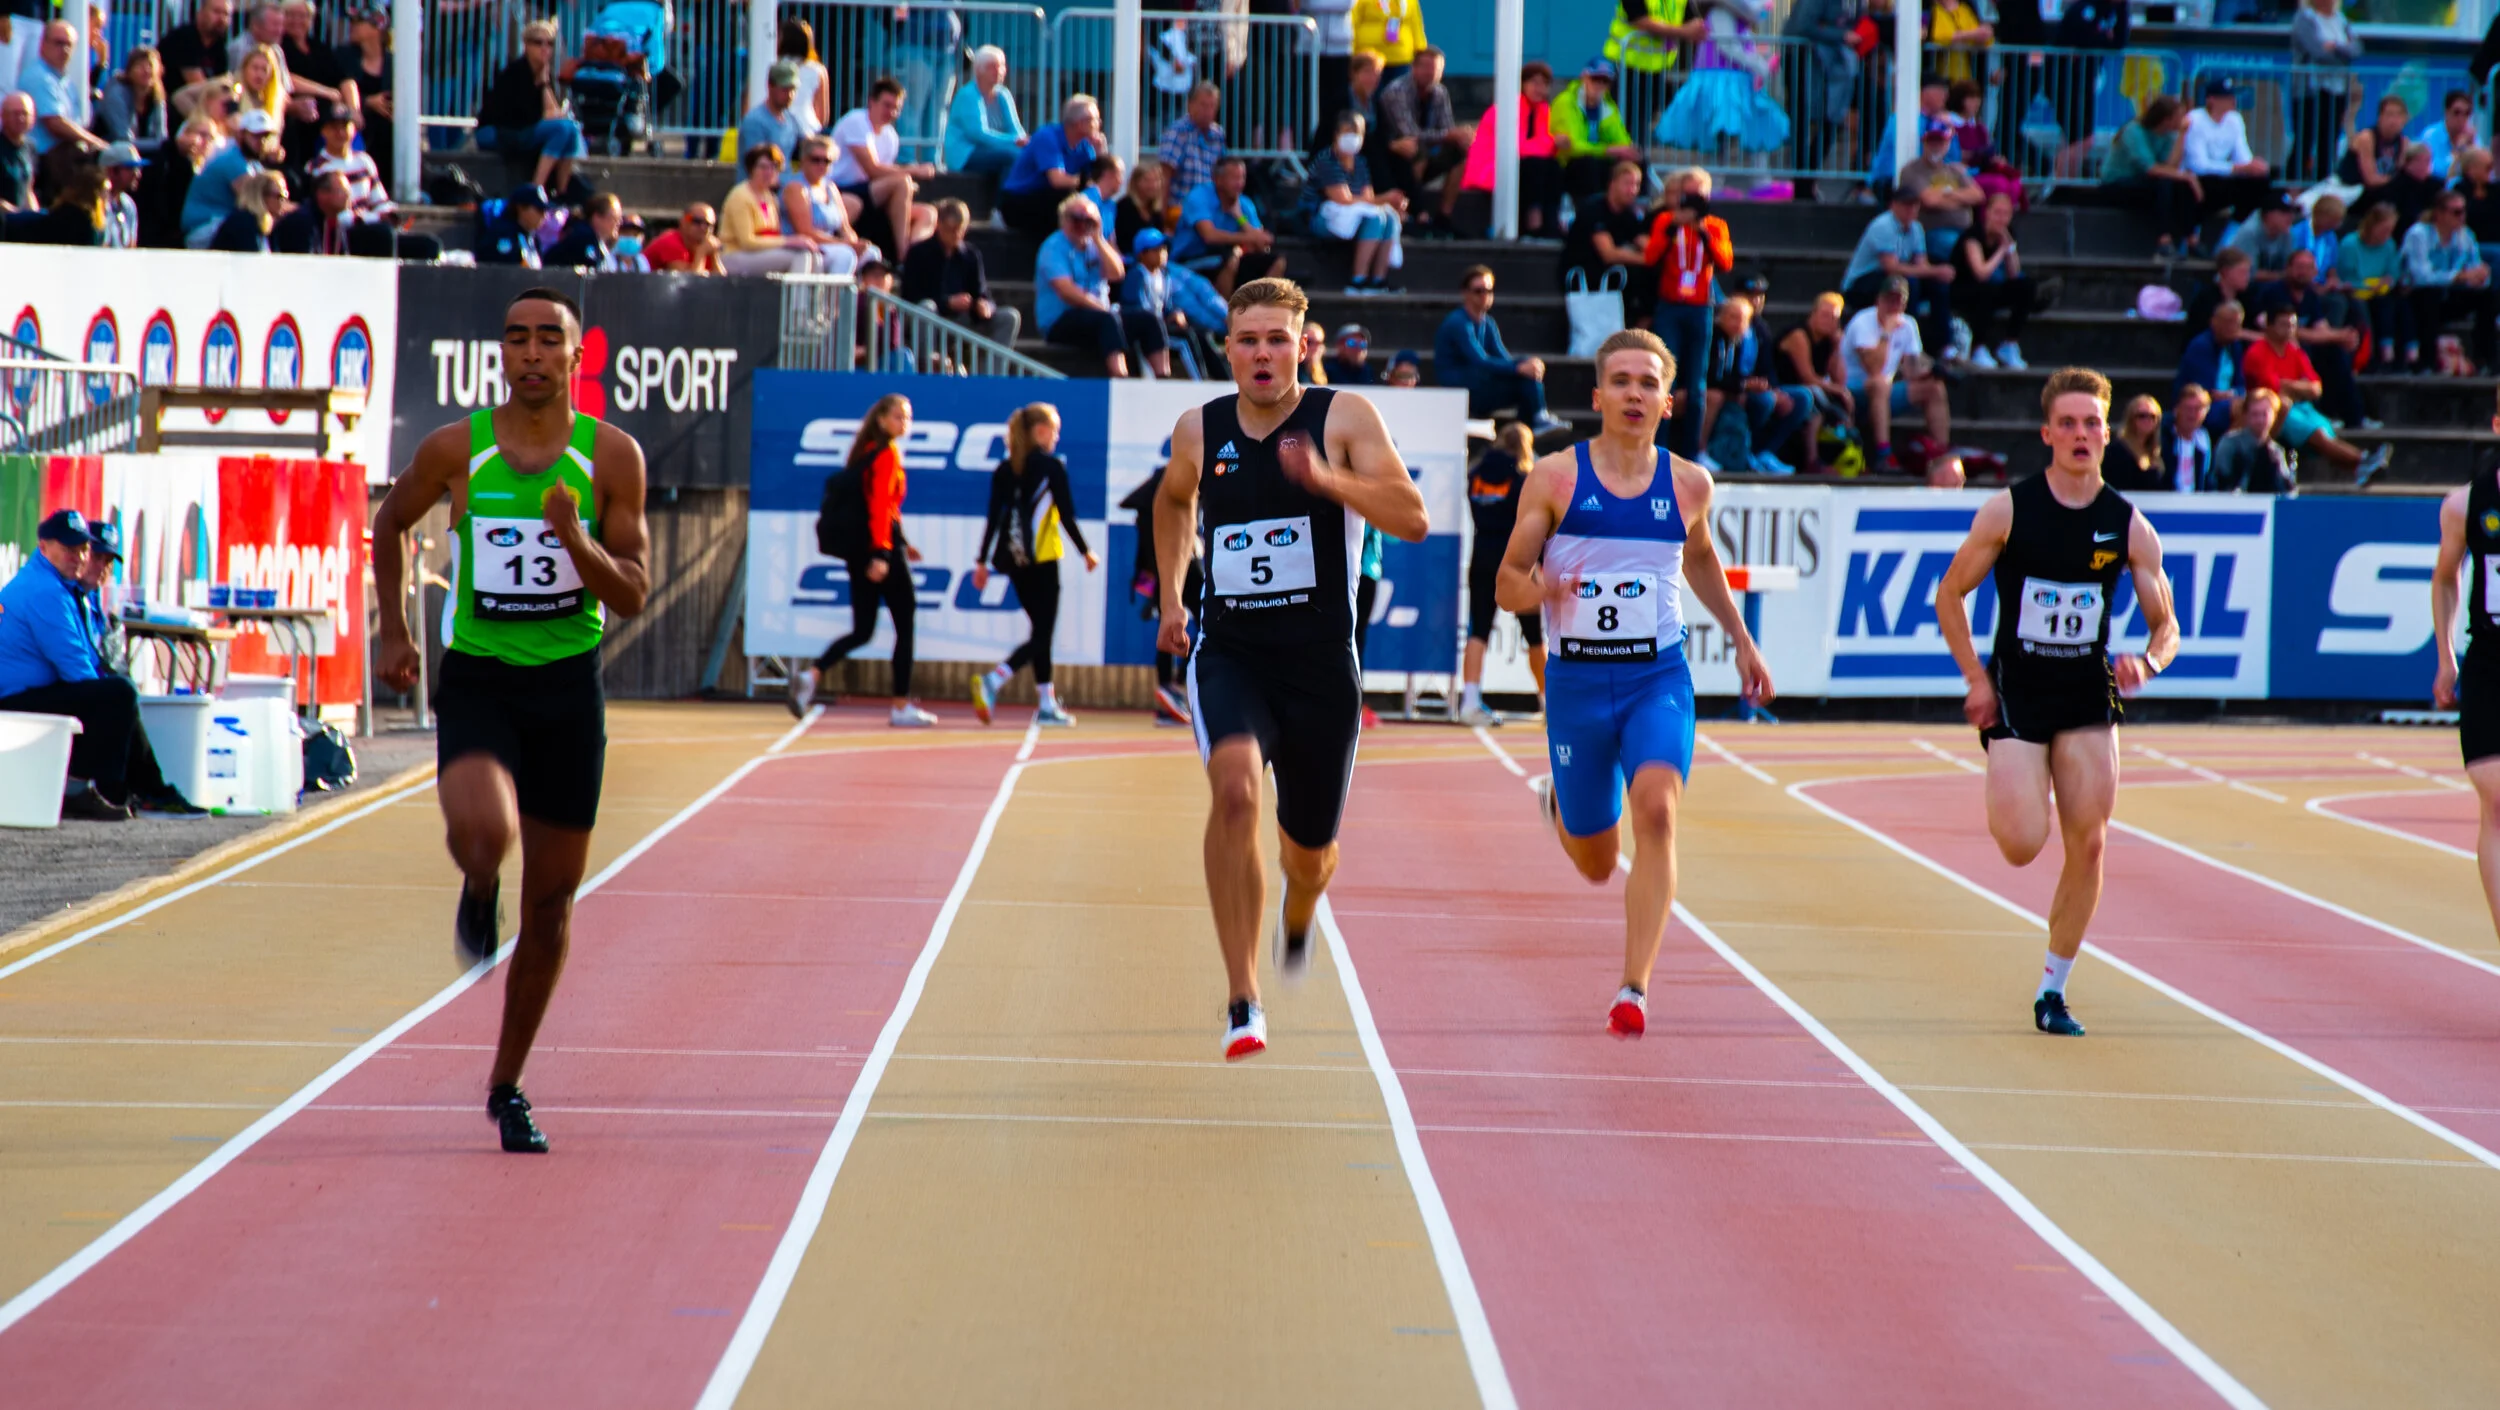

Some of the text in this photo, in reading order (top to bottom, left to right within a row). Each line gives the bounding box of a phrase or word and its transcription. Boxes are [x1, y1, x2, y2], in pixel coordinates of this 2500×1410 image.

[431, 339, 738, 413] TUR SPORT
[1217, 451, 1239, 459] adidas
[1227, 463, 1239, 473] OP
[1709, 506, 1821, 577] SIUS
[504, 555, 558, 587] 13
[1250, 556, 1274, 586] 5
[1597, 605, 1619, 632] 8
[2044, 611, 2083, 639] 19
[1582, 645, 1632, 656] MEDIALIIGA
